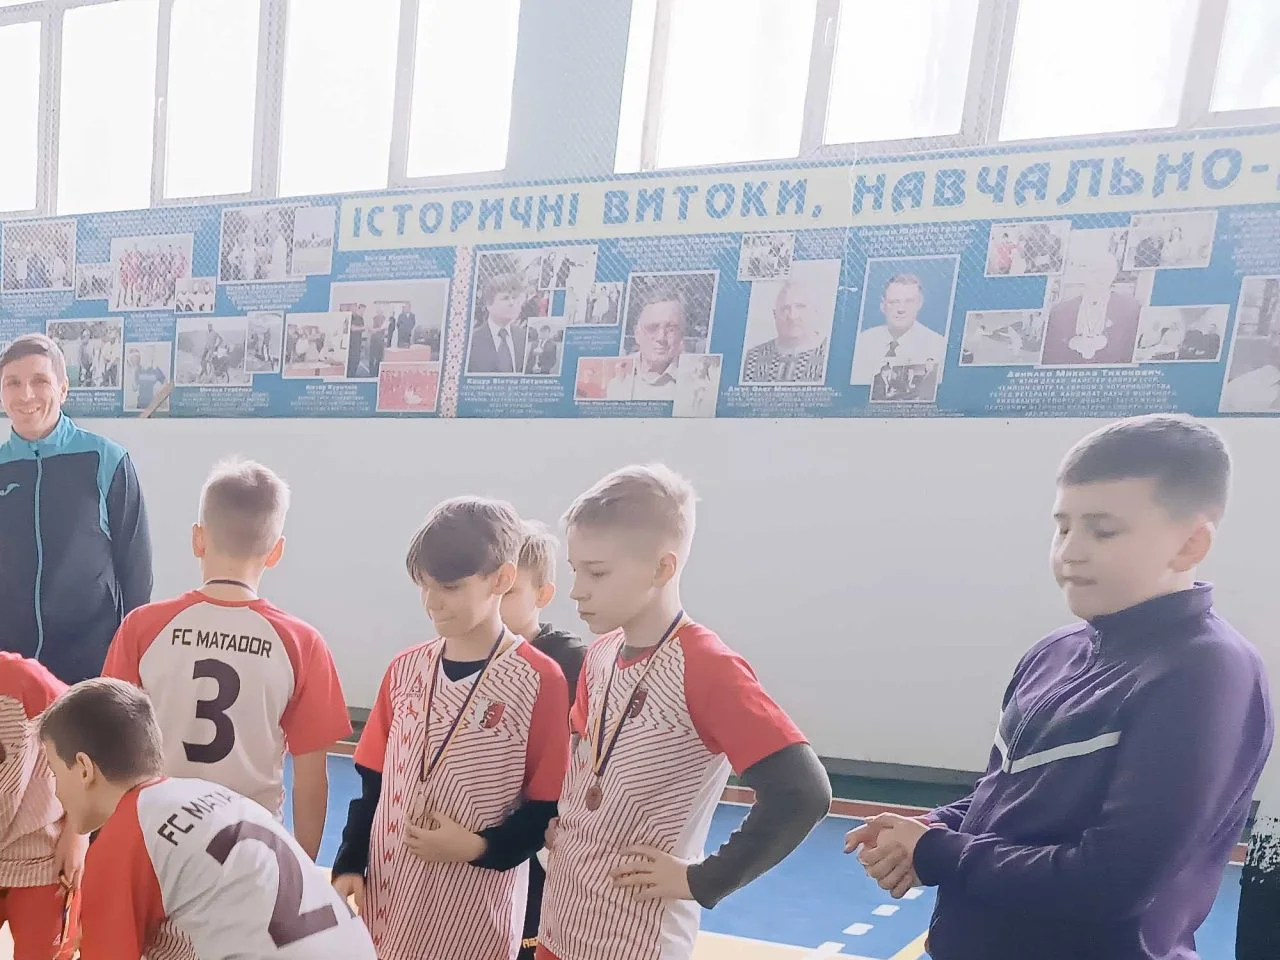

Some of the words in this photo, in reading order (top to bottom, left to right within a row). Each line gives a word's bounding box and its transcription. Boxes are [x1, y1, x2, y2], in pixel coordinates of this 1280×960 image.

[352, 192, 580, 238] ІСТОРИЧНІ
[602, 178, 825, 225] ВИТОКИ,
[851, 148, 1280, 217] НАВЧАЛЬНО-
[171, 628, 193, 646] FC
[196, 630, 272, 658] MATADOR
[183, 658, 240, 764] 3
[157, 813, 194, 846] FC
[205, 820, 339, 949] 2
